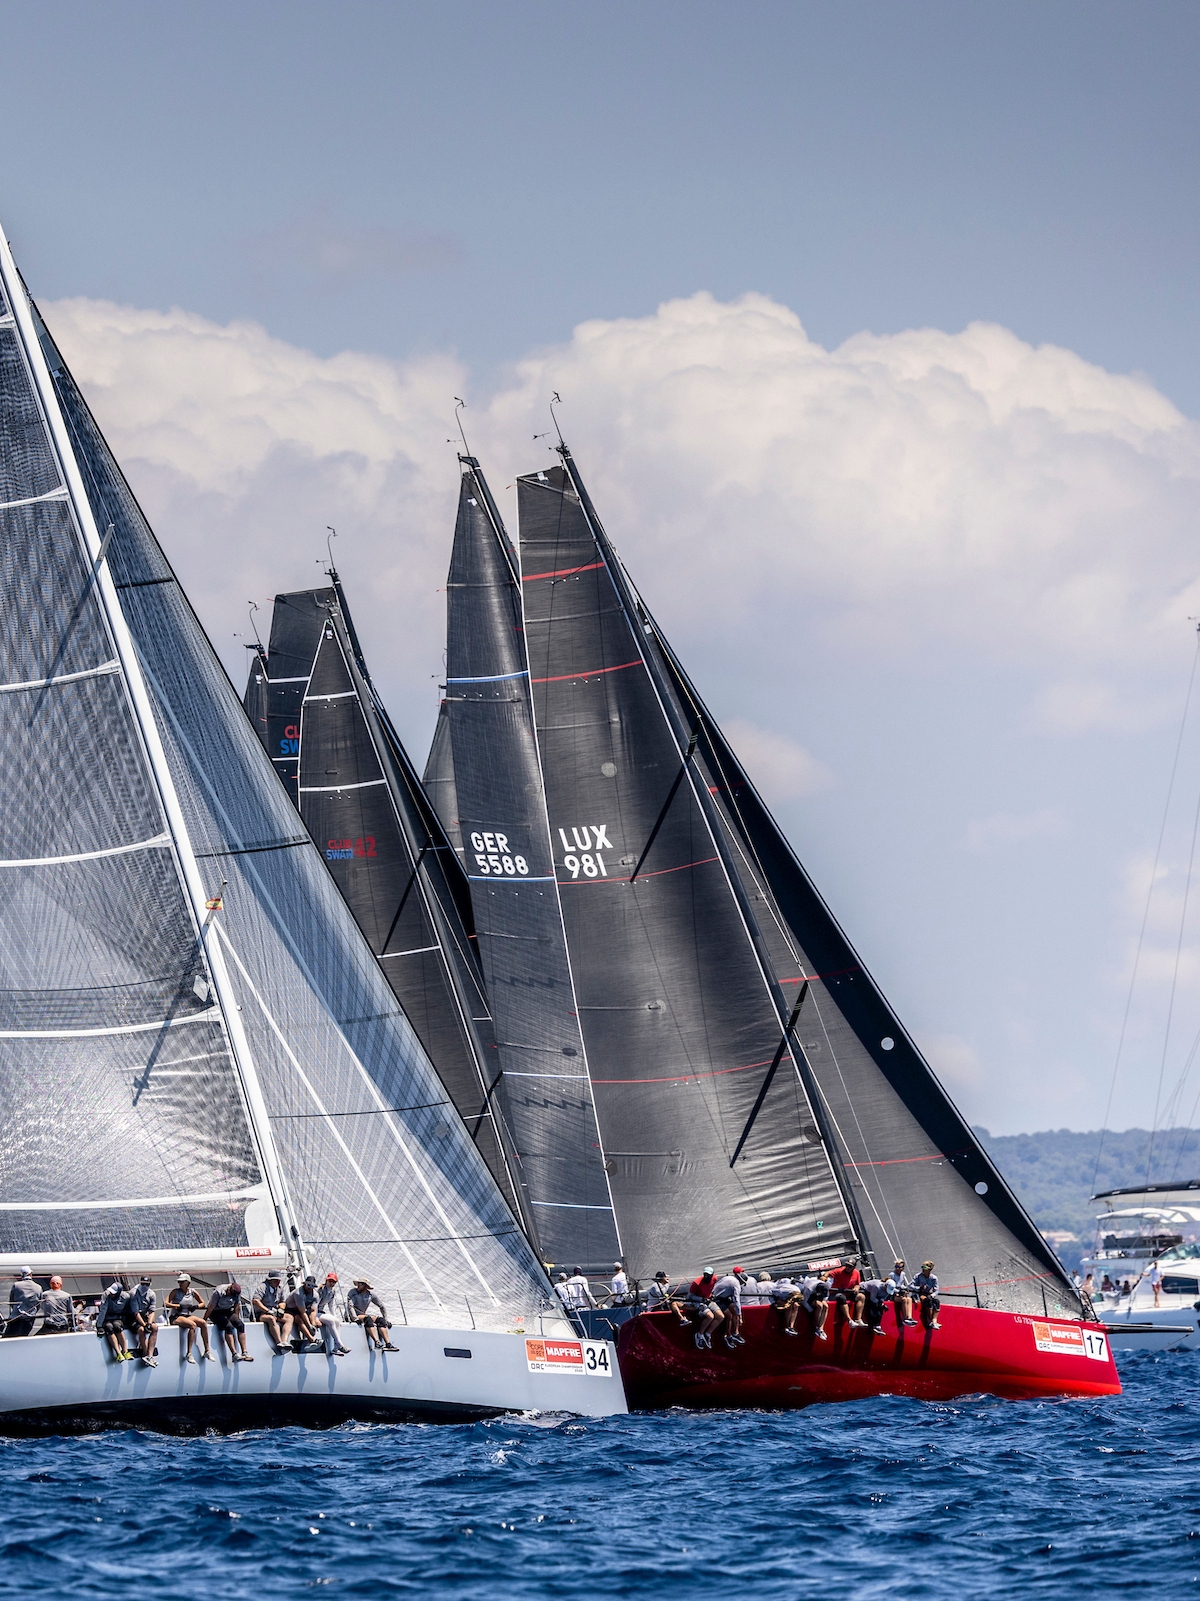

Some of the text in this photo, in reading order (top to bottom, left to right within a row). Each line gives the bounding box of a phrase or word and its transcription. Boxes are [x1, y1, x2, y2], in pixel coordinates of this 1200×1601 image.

[284, 725, 300, 739] CL
[280, 739, 300, 754] SW
[327, 839, 352, 850] CLUB
[471, 832, 511, 853] GER
[559, 824, 613, 852] LUX
[326, 848, 354, 861] SWAN
[353, 836, 377, 859] 42
[475, 854, 529, 875] 5588
[564, 852, 607, 879] 981
[811, 1260, 839, 1269] MAPFRE
[1051, 1330, 1081, 1340] MAPFRE
[546, 1347, 581, 1357] MAPFRE
[1086, 1335, 1104, 1355] 17
[586, 1347, 609, 1371] 34
